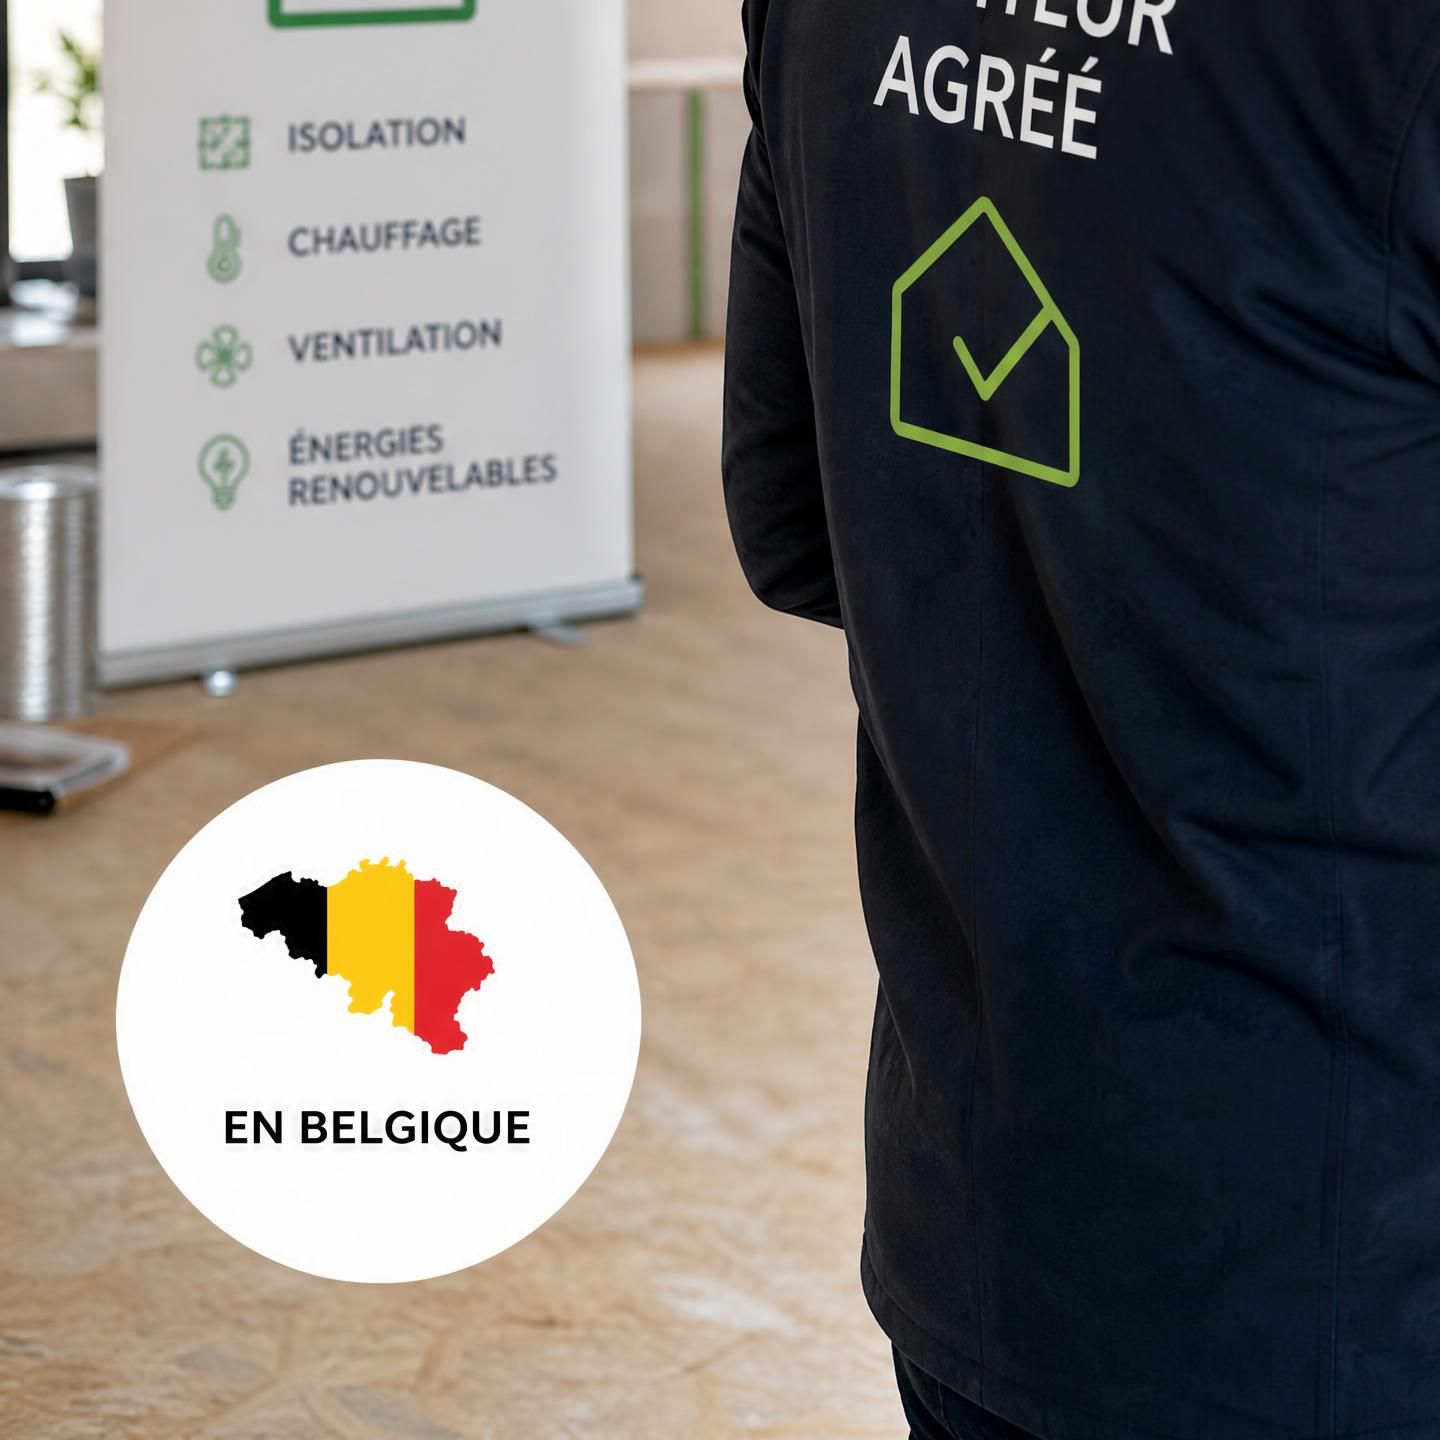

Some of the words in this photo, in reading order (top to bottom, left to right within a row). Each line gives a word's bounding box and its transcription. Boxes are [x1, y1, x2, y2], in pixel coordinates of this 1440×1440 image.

[873, 35, 1102, 160] AGRÉÉ
[287, 115, 467, 153] ISOLATION
[287, 216, 481, 258] CHAUFFAGE
[287, 318, 503, 363] VENTILATION
[287, 423, 445, 466] ÉNERGIES
[288, 453, 558, 508] RENOUVELABLES
